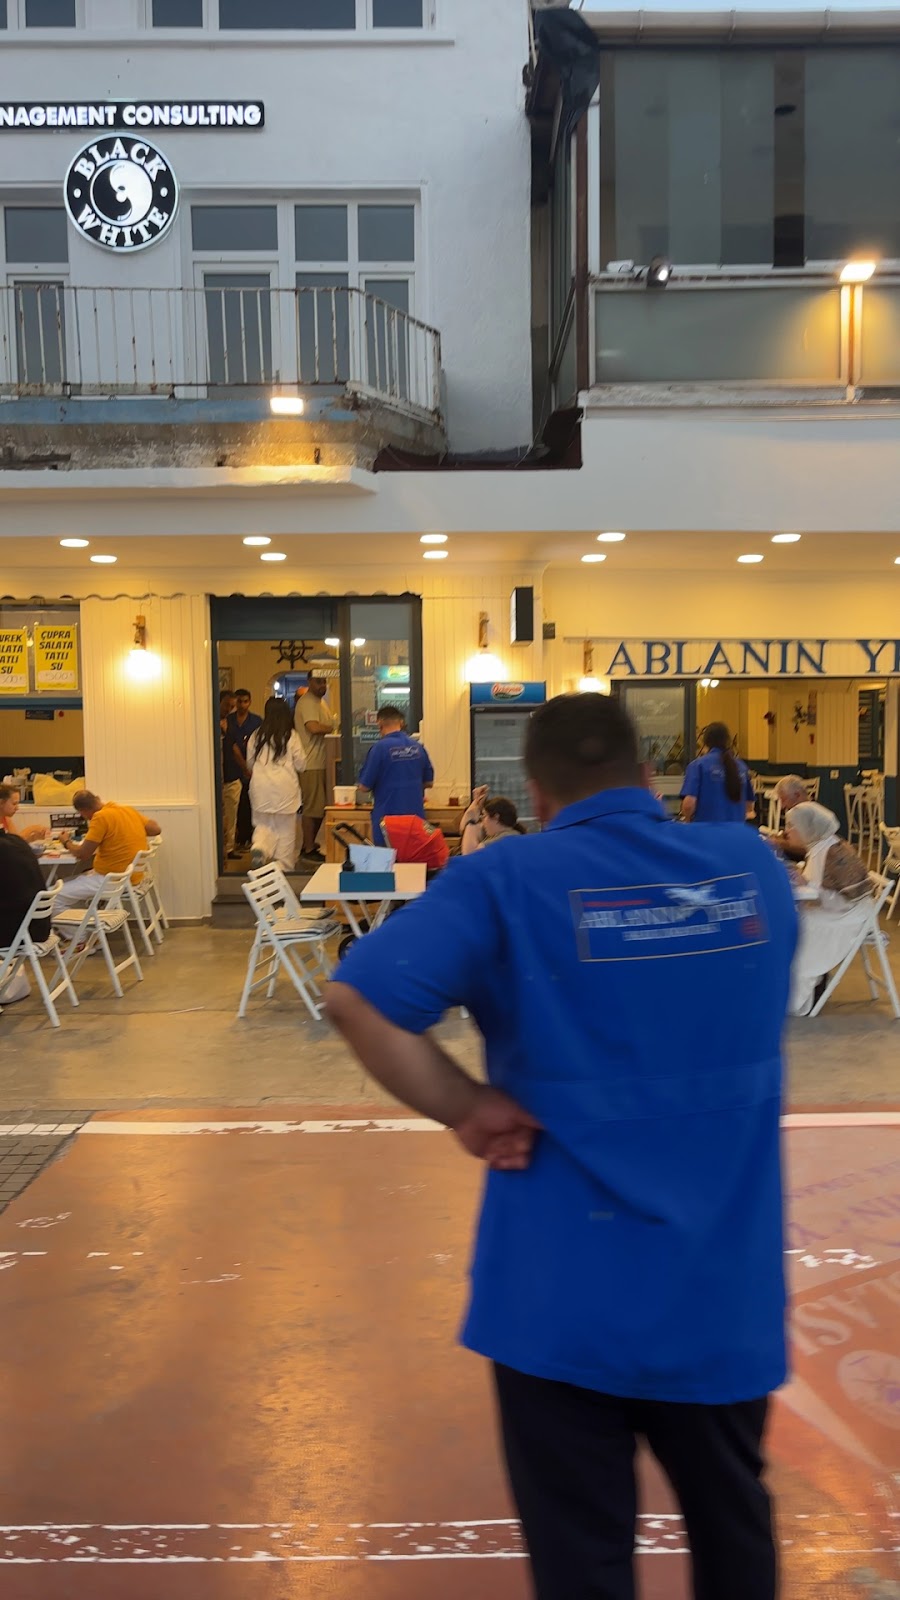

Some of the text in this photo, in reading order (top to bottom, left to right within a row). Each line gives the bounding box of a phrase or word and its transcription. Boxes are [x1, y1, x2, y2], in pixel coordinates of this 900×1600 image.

[0, 105, 262, 126] NAGEMENT CONSULTING
[74, 138, 167, 182] BLACK
[78, 204, 168, 246] WHITE
[41, 631, 70, 640] ÇUPRA
[39, 641, 73, 650] SALATA
[45, 652, 69, 660] TATLI
[606, 639, 900, 676] ABLANIN Y
[1, 666, 14, 674] SU
[50, 662, 63, 670] SU
